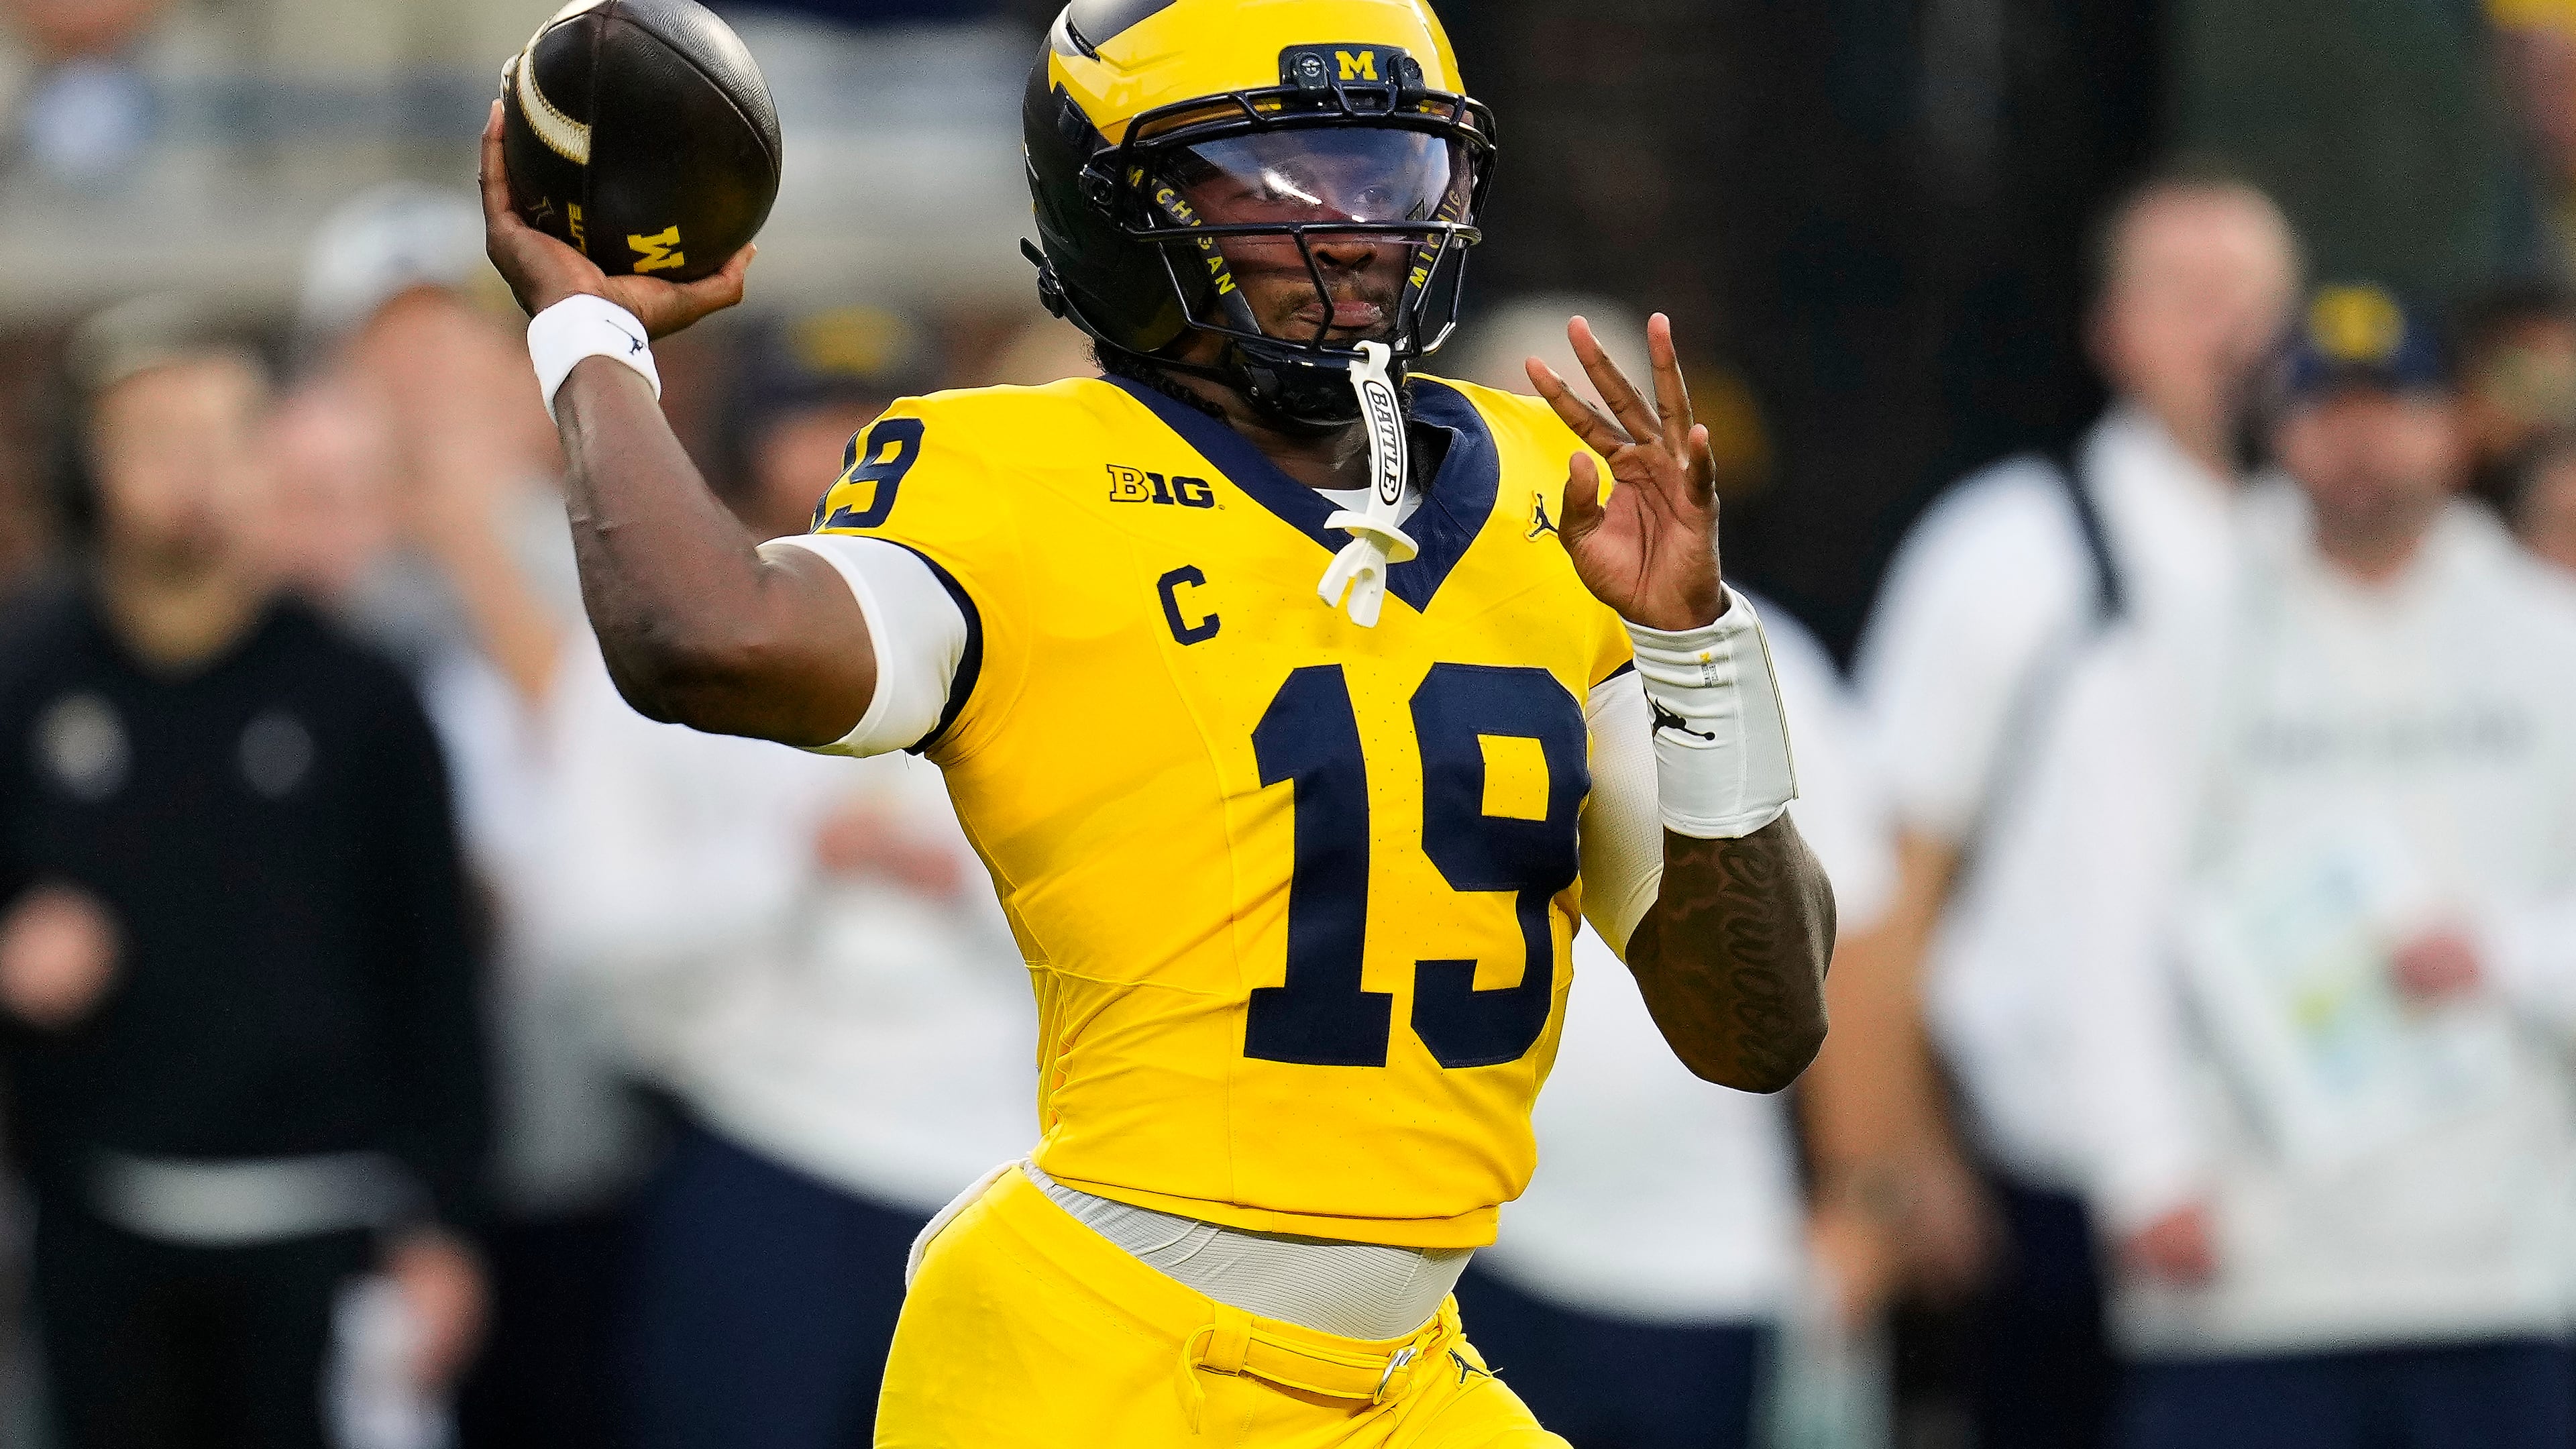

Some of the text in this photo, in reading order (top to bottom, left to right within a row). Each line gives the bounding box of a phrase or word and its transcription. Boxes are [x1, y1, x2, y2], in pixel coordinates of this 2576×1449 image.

[1335, 50, 1378, 80] M
[627, 225, 685, 274] M
[1370, 390, 1397, 492] BATTLE
[1157, 564, 1220, 646] C
[1244, 662, 1591, 1069] 19
